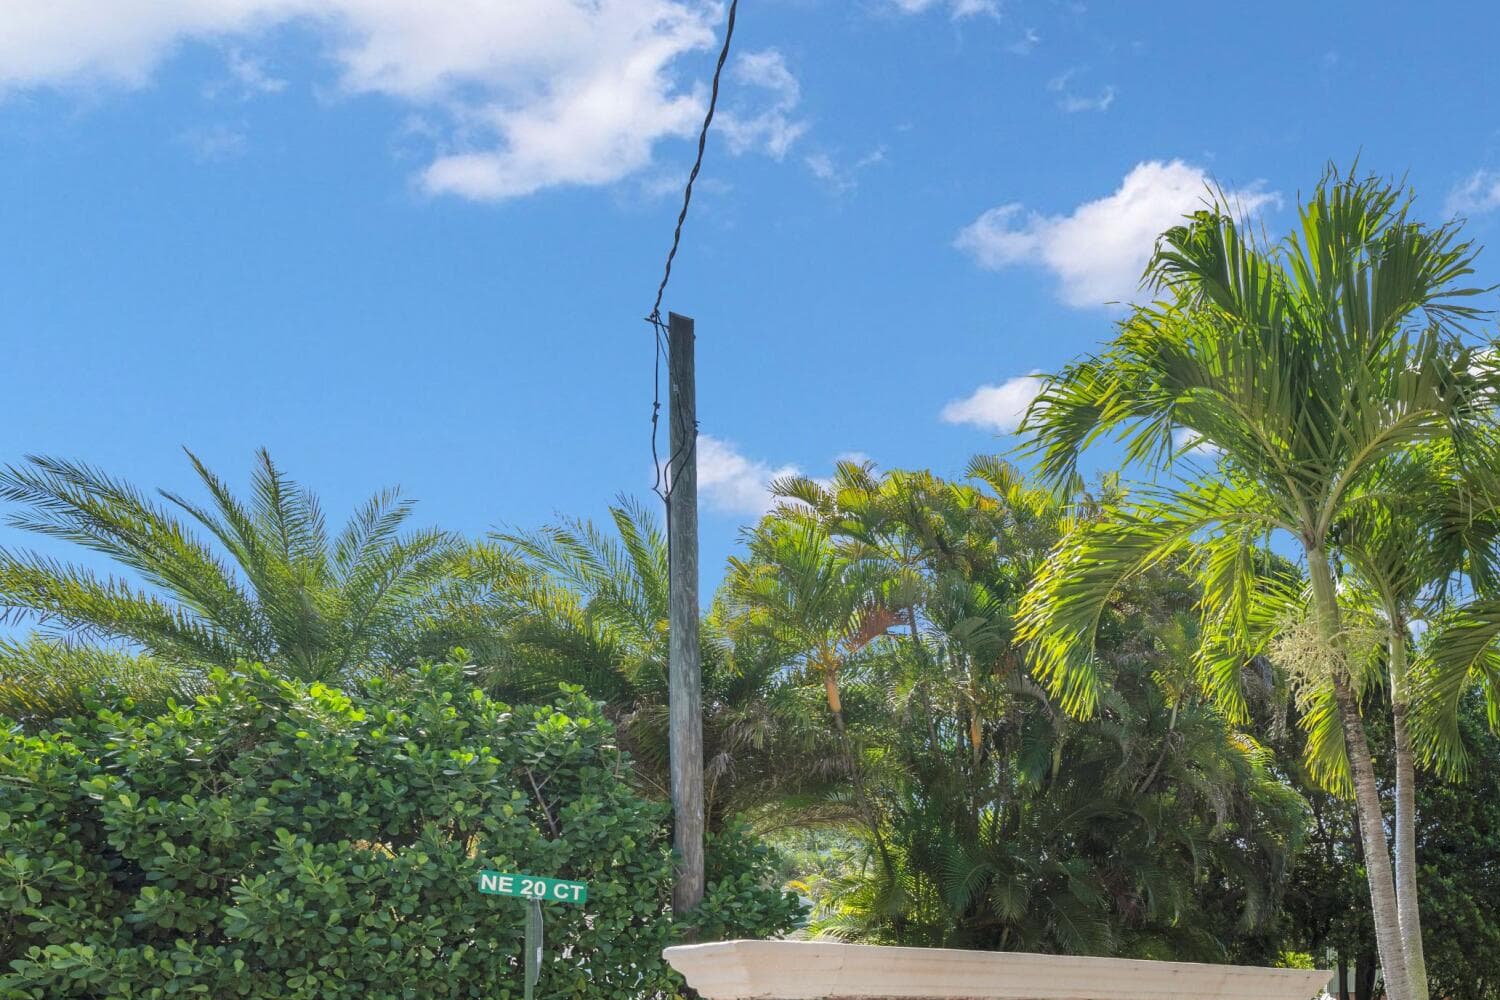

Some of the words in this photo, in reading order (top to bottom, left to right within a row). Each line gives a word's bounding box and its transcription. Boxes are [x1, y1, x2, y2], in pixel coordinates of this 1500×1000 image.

[481, 874, 514, 893] NE
[520, 879, 546, 896] 20
[553, 883, 584, 900] CT
